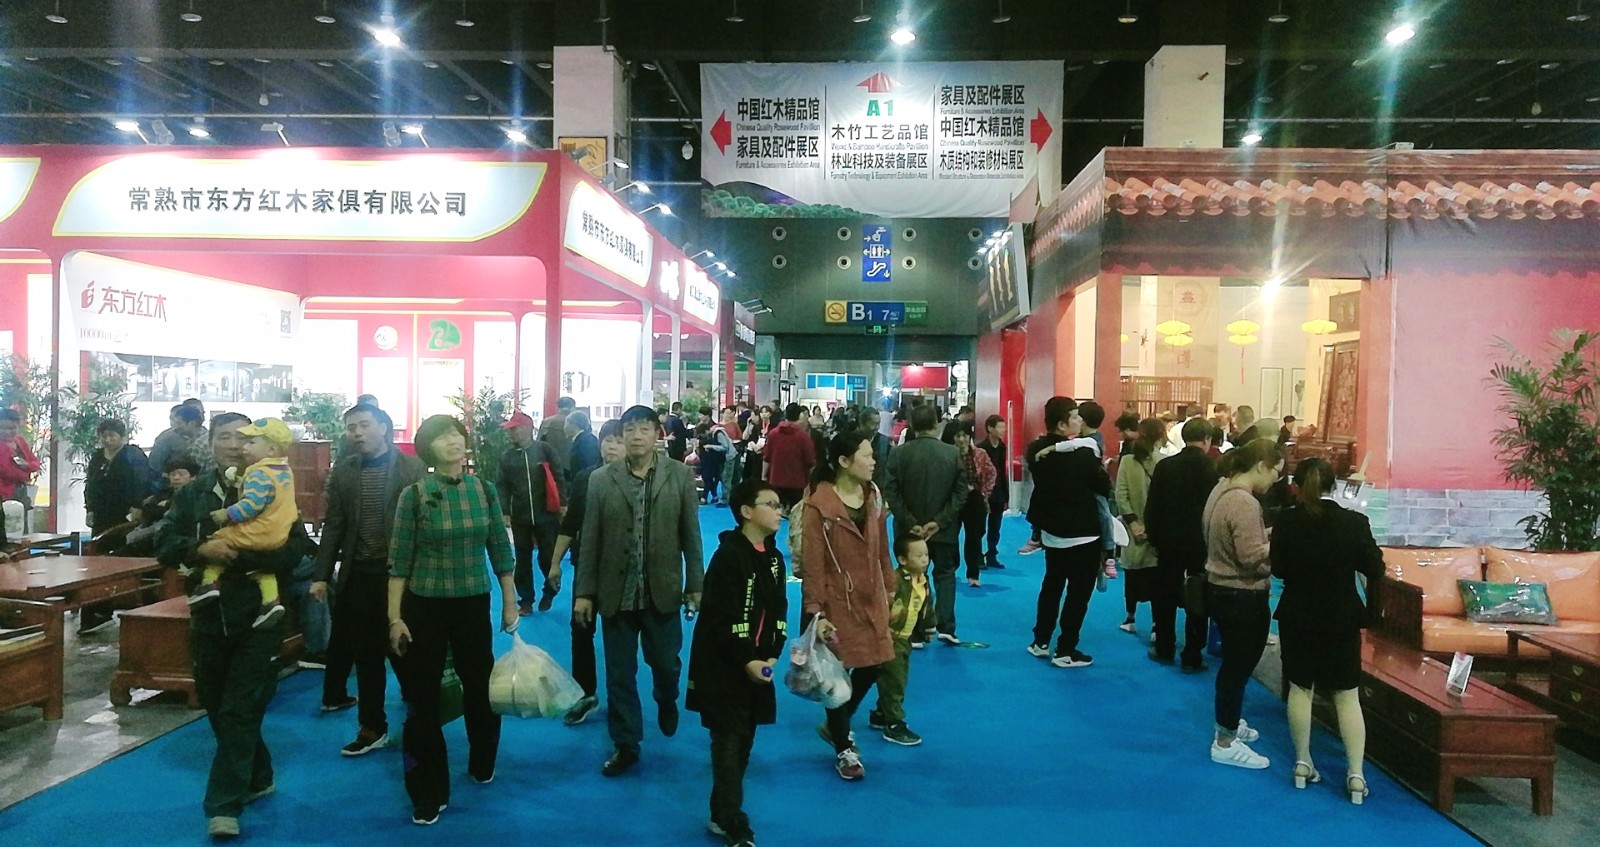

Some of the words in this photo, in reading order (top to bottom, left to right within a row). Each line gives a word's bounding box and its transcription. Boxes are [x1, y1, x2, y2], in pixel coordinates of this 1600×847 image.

[941, 84, 1025, 106] 家具及配件展区
[737, 97, 820, 121] 中国红木精品馆
[866, 99, 894, 116] A1
[831, 124, 928, 140] 木竹工艺品馆
[940, 116, 1025, 138] 中国红木精品馆
[737, 135, 819, 158] 家具及配件展区
[831, 152, 928, 169] 林业科技及装备展区
[940, 149, 1024, 171] 木质结构和装修材料展区
[128, 186, 467, 217] 常熟市东方红木家俱有限公司
[98, 286, 167, 322] 东方红木
[851, 303, 873, 321] B1
